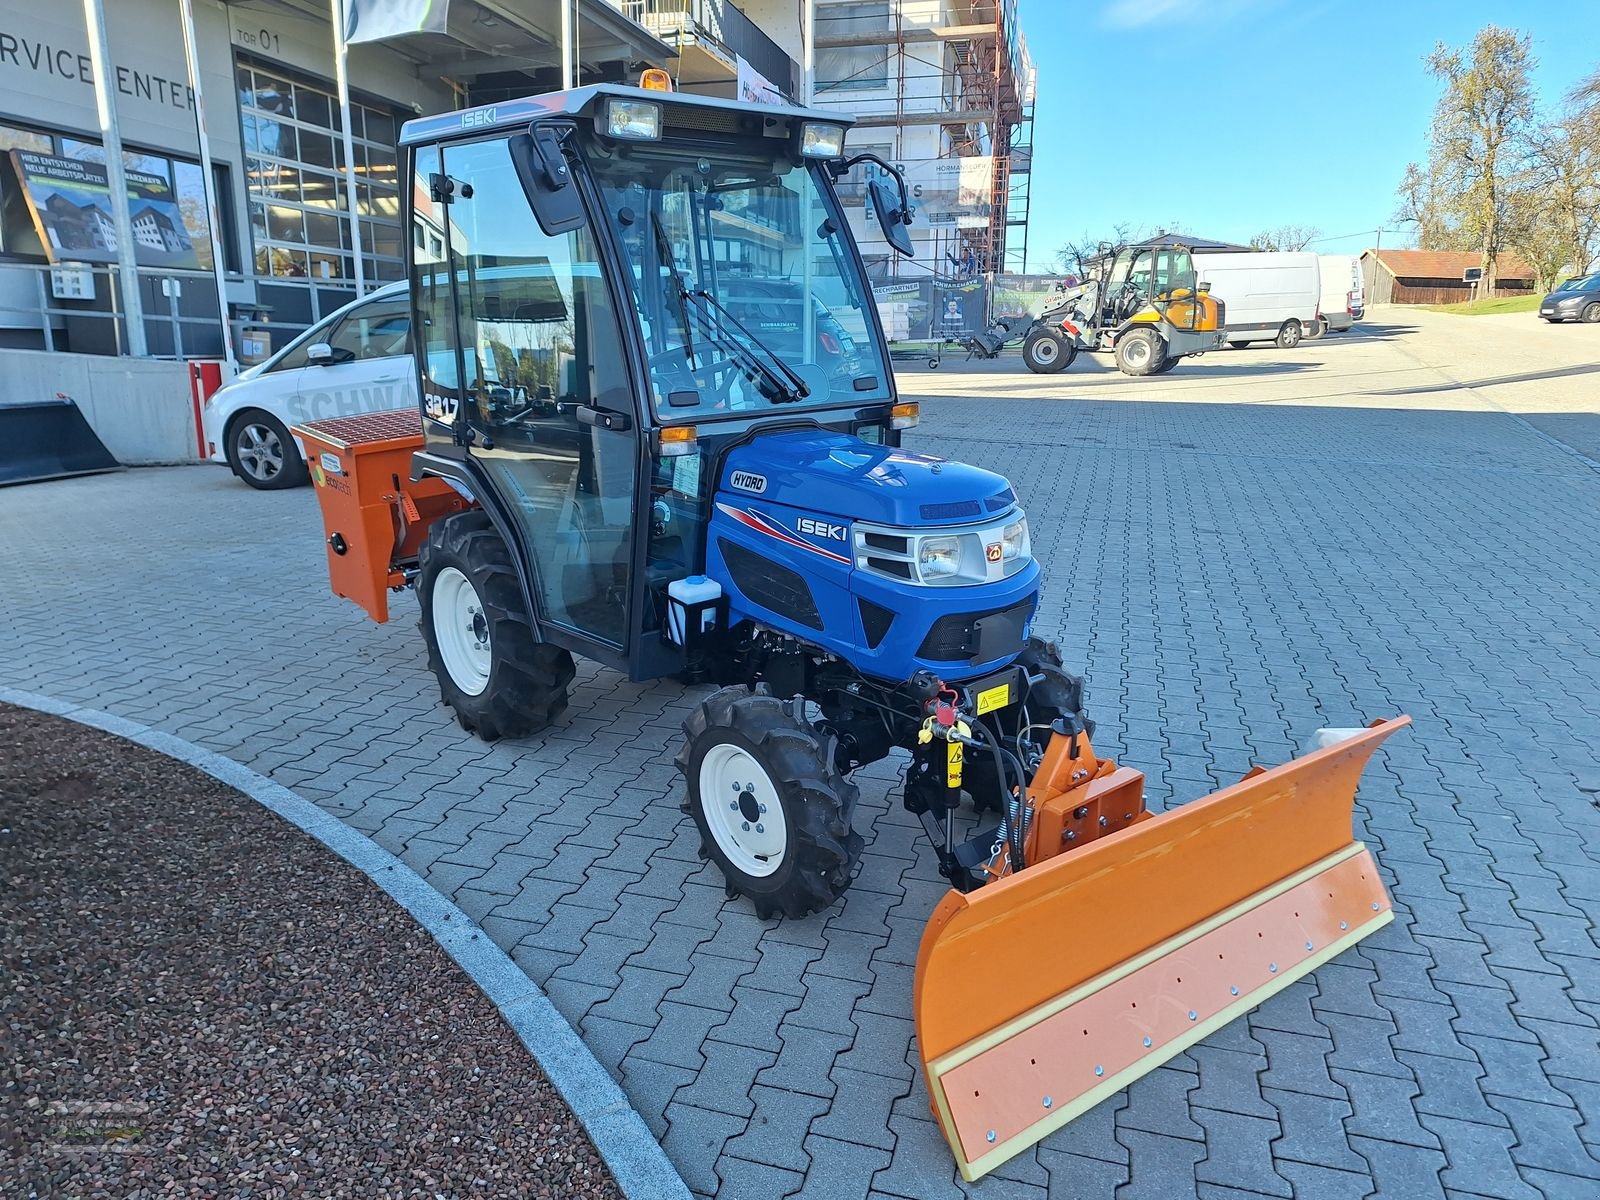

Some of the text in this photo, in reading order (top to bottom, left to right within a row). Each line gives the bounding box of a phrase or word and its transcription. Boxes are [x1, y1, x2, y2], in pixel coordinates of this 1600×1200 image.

[236, 28, 280, 54] TOR 01
[460, 107, 498, 129] ISEKI
[21, 153, 40, 165] HIER
[24, 162, 48, 175] NEUE
[872, 282, 919, 294] RECHPARTNER
[425, 393, 459, 420] 3217
[733, 473, 764, 490] HYDRO
[796, 517, 848, 541] ISEKI
